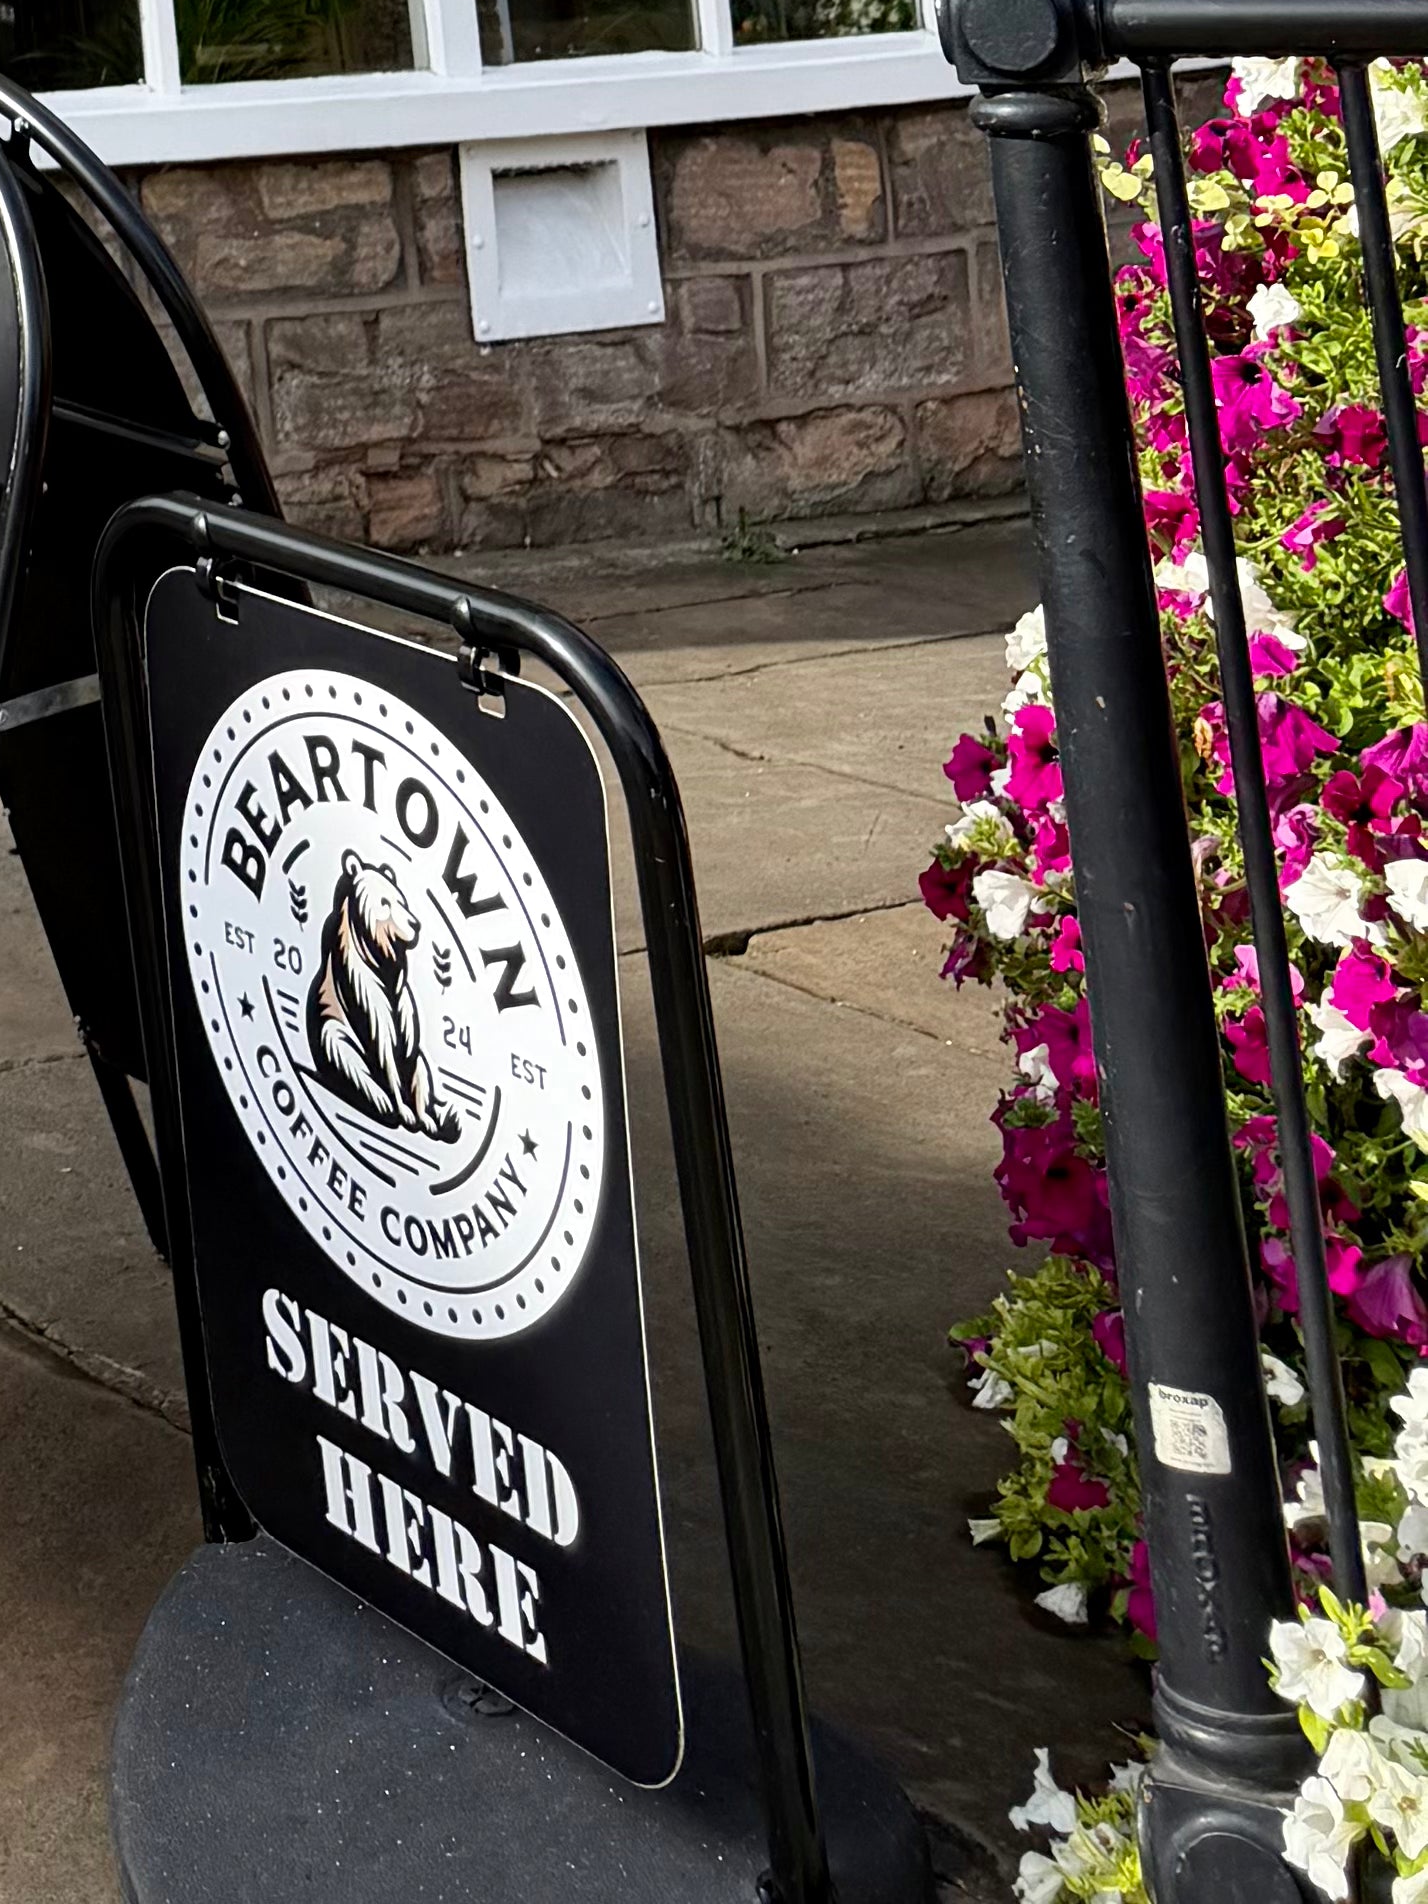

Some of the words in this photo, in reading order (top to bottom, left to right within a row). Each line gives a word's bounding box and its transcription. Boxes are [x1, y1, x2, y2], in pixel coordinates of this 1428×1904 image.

[221, 735, 542, 1014] BEARTOWN
[224, 921, 255, 955] EST
[273, 937, 302, 975] 20
[442, 1016, 471, 1057] 24
[511, 1053, 547, 1091] EST
[255, 1044, 367, 1222] COFFEE
[379, 1153, 528, 1260] COMPANY
[262, 1288, 578, 1547] SERVED
[1158, 1387, 1209, 1409] broxap
[316, 1435, 547, 1665] HERE
